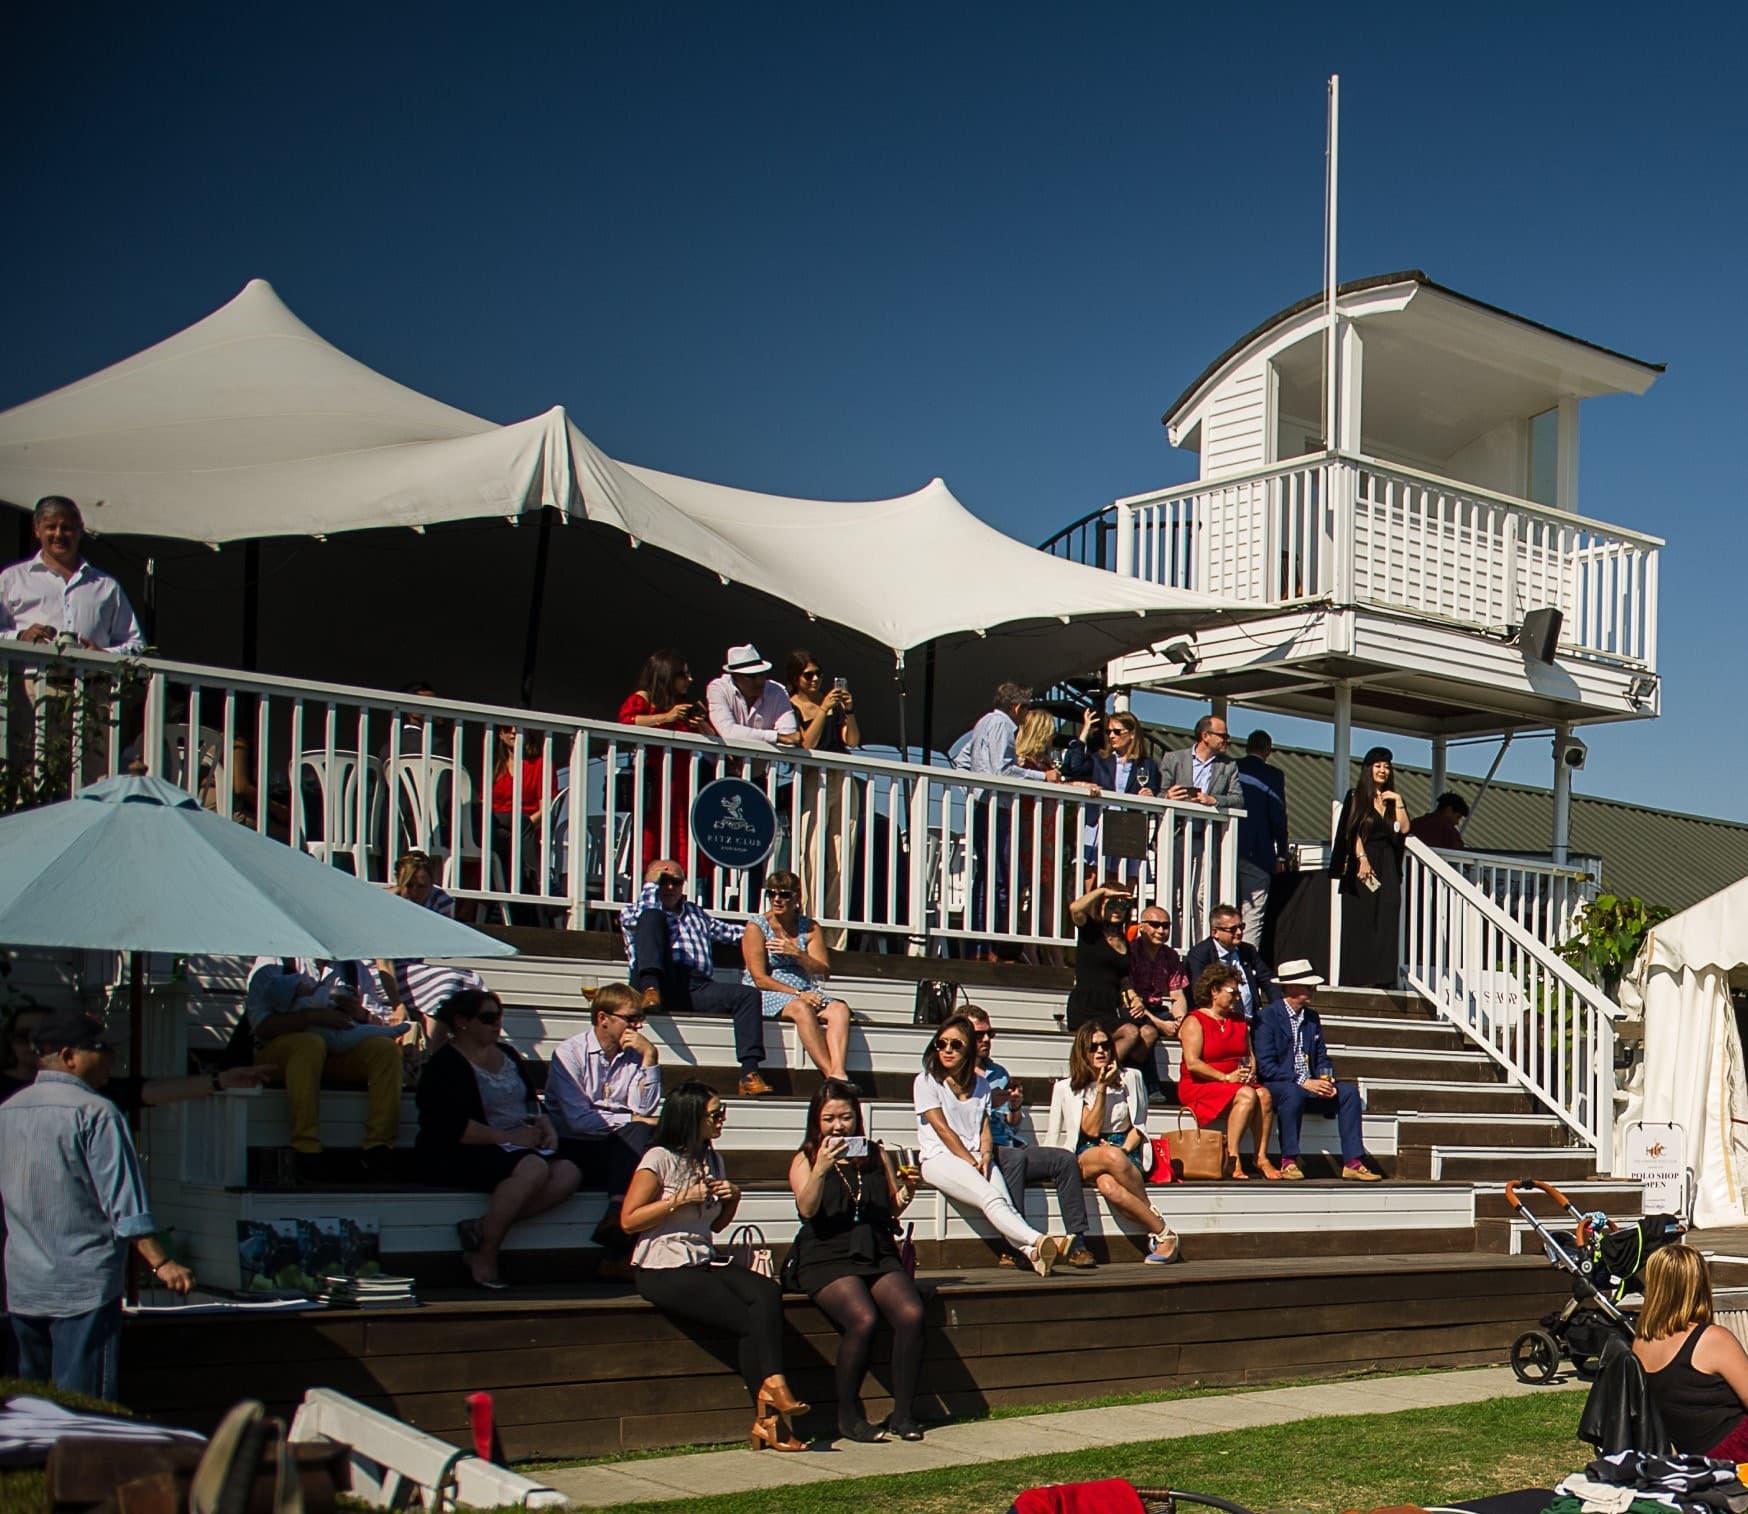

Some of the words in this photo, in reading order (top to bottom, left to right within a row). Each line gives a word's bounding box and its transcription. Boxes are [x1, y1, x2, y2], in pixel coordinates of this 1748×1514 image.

[735, 836, 762, 847] CLUB
[1631, 1172, 1655, 1180] POLO
[1656, 1172, 1679, 1180] SHOP
